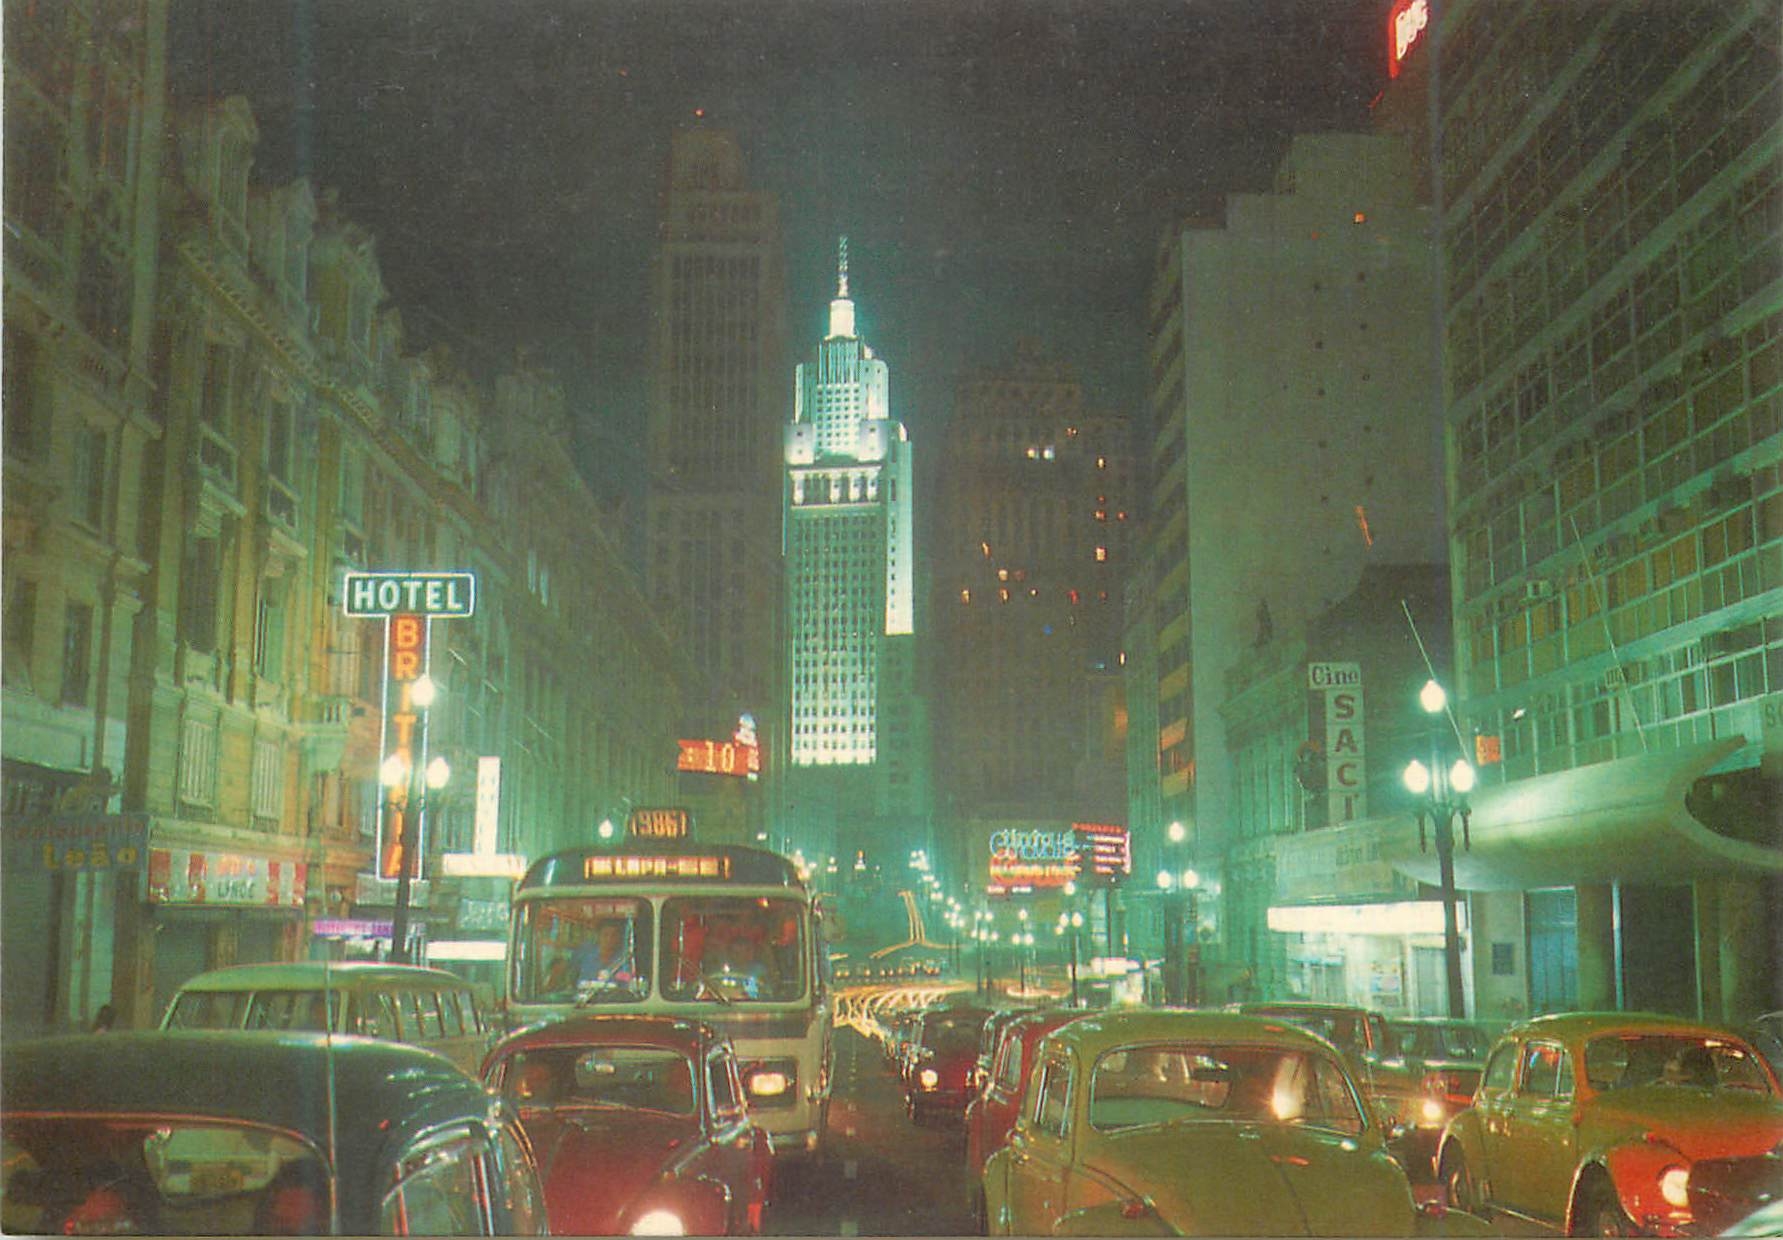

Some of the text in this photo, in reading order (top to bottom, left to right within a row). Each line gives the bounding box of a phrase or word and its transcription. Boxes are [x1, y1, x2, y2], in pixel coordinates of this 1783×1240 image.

[353, 579, 464, 611] HOTEL
[1311, 665, 1359, 686] Cine
[1333, 694, 1360, 821] SACI
